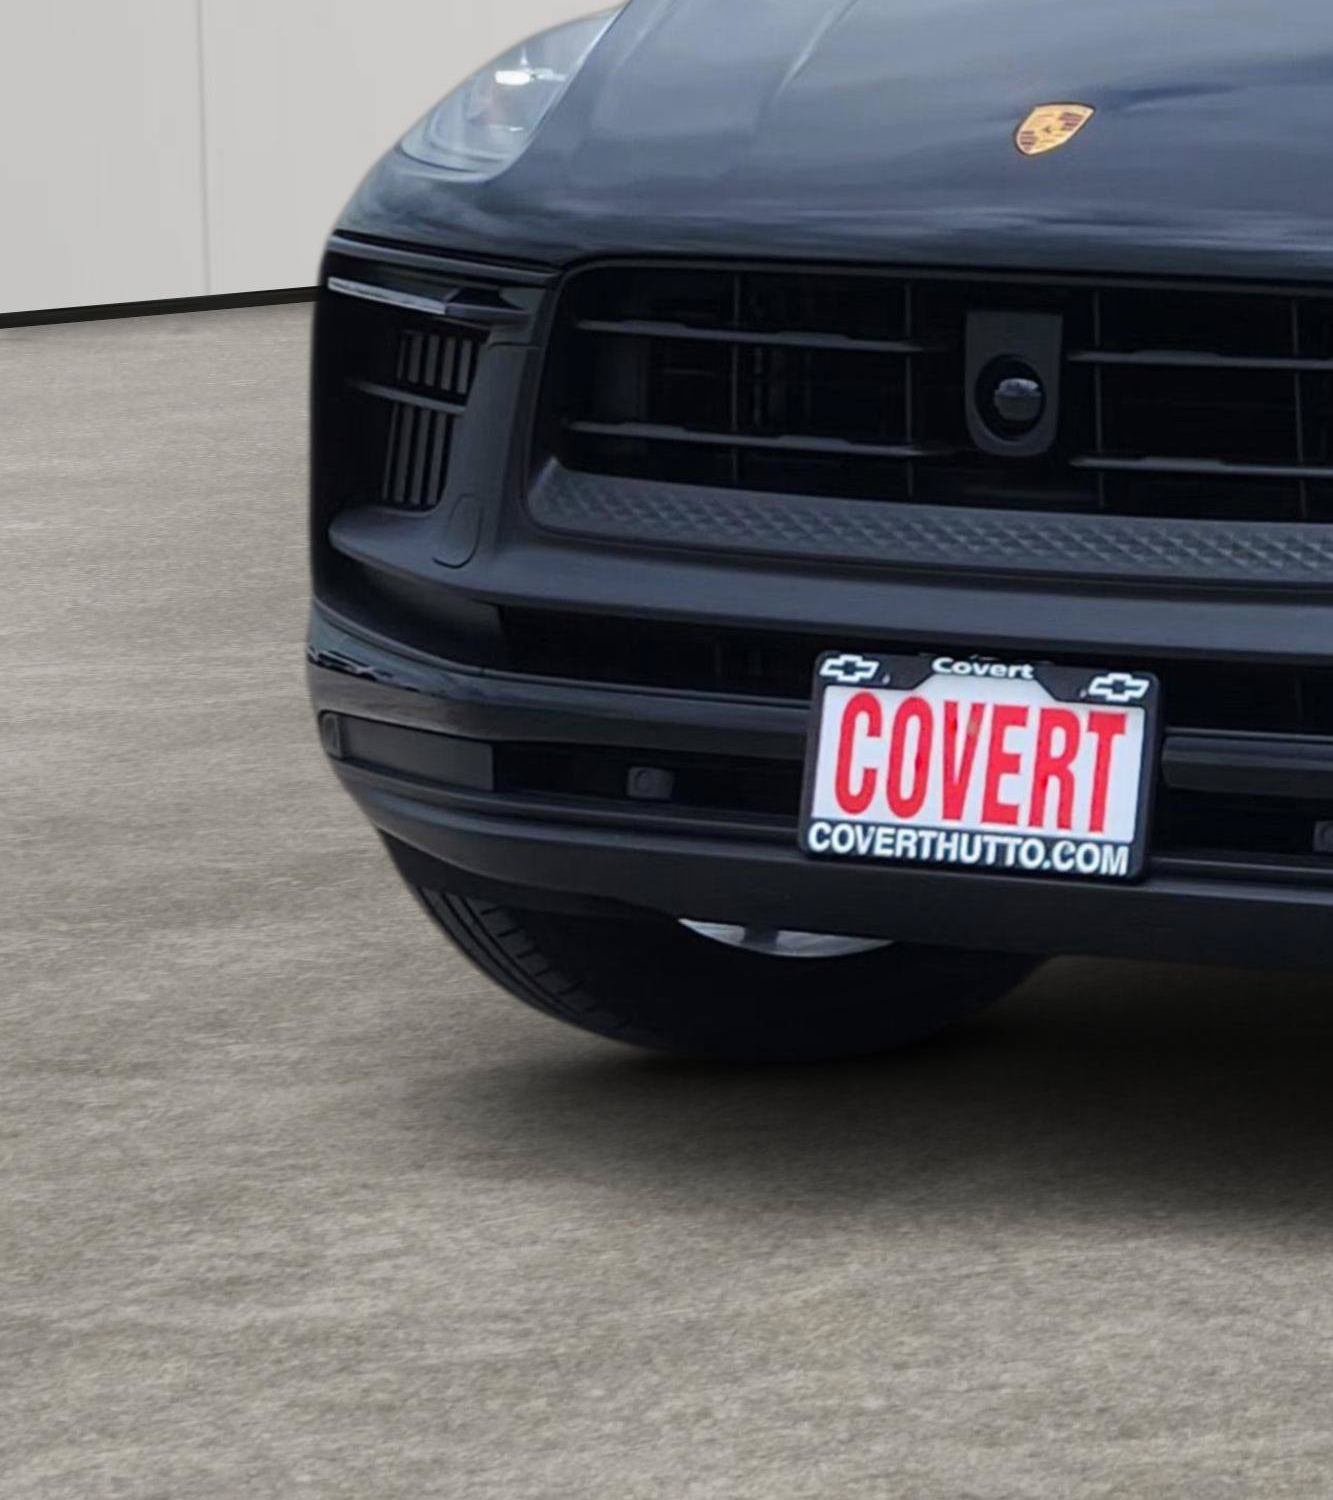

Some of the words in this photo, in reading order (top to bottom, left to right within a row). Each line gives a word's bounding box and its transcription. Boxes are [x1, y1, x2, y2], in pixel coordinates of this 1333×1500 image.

[932, 657, 1033, 679] Covert
[835, 690, 1128, 833] COVERT
[807, 822, 1129, 875] COVERTHUTTO.COM
